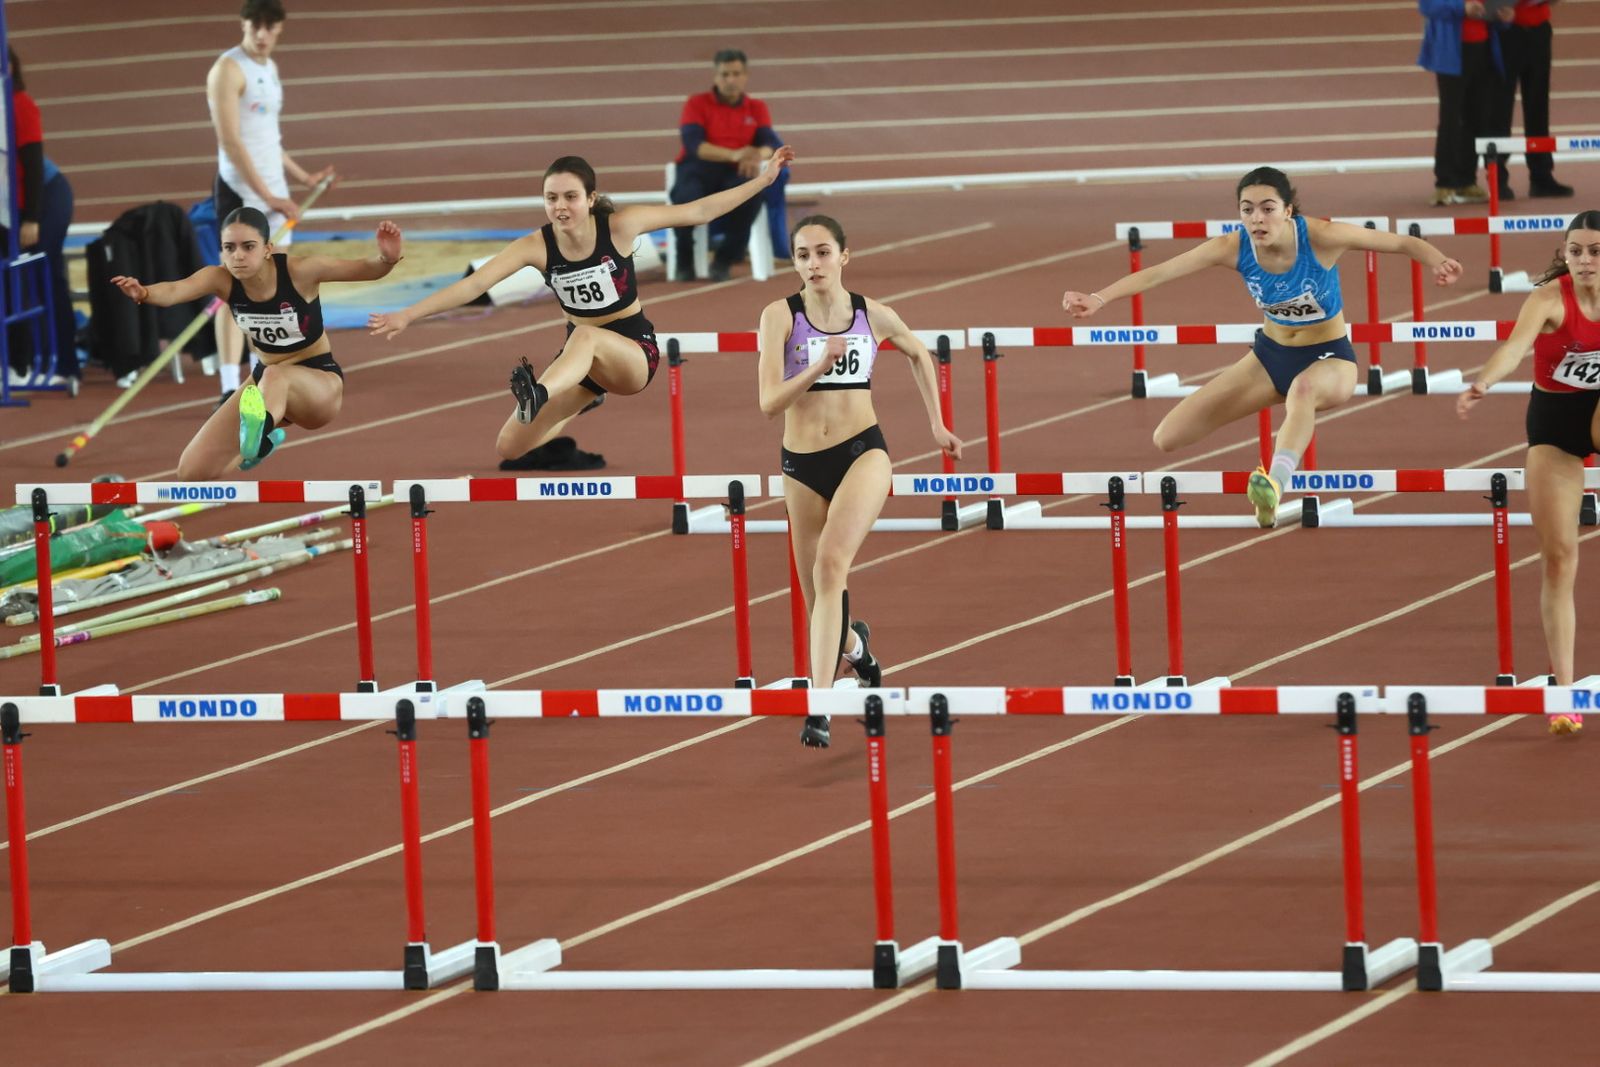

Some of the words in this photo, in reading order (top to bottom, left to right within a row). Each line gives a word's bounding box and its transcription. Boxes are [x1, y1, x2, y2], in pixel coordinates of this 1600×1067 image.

[1503, 217, 1565, 231] MONDO
[562, 281, 605, 305] 758
[248, 326, 290, 344] 760
[1089, 327, 1160, 343] MONDO
[1412, 325, 1477, 338] MONDO
[1563, 360, 1600, 384] 142
[540, 481, 612, 496] MONDO
[913, 476, 996, 493] MONDO
[1291, 473, 1375, 491] MONDO
[170, 485, 237, 501] MONDO
[159, 699, 257, 718] MONDO
[624, 693, 724, 713] MONDO
[1089, 691, 1193, 711] MONDO
